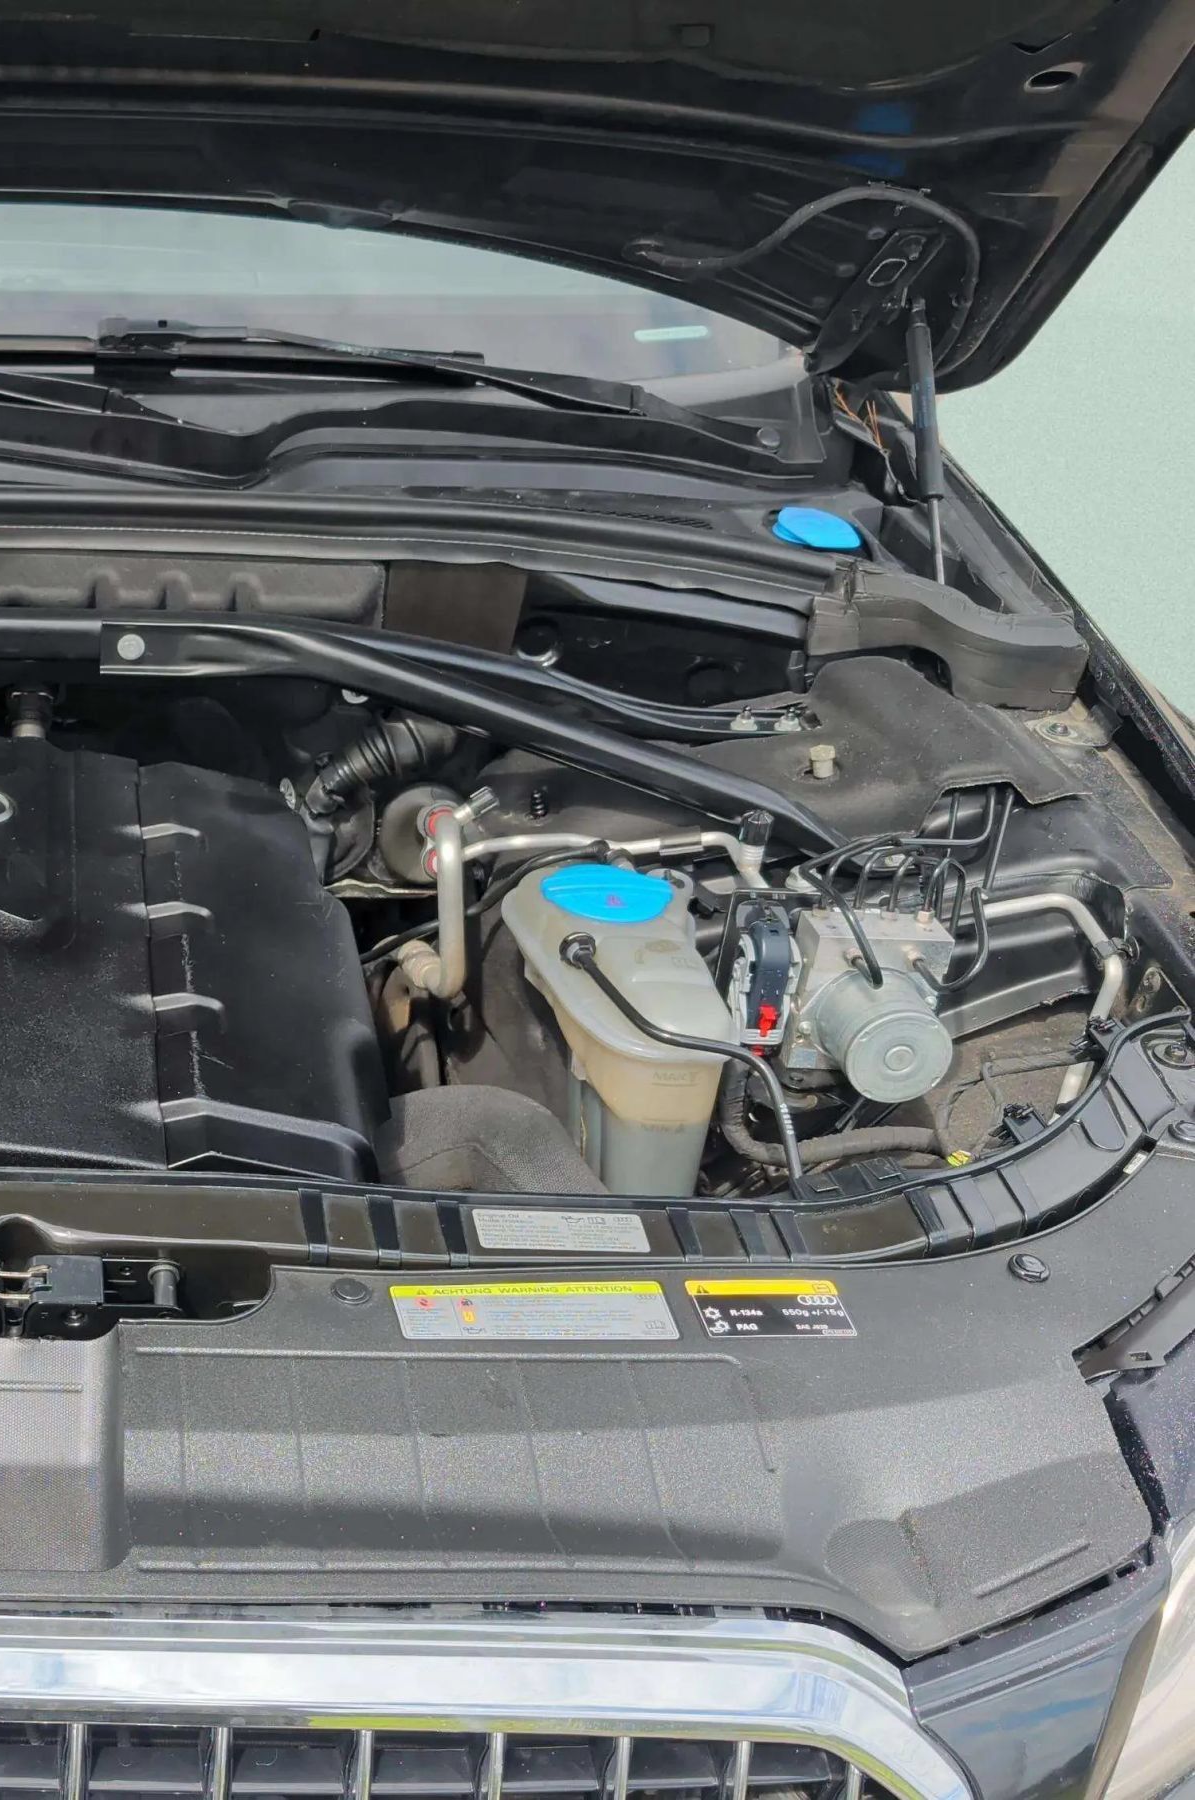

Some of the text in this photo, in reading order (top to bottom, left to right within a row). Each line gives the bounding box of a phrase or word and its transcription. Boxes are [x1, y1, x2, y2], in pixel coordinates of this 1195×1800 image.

[432, 1285, 633, 1295] ACHTUNG WARNING ATTENTION
[730, 1309, 764, 1317] R-134a
[736, 1323, 759, 1331] PAG
